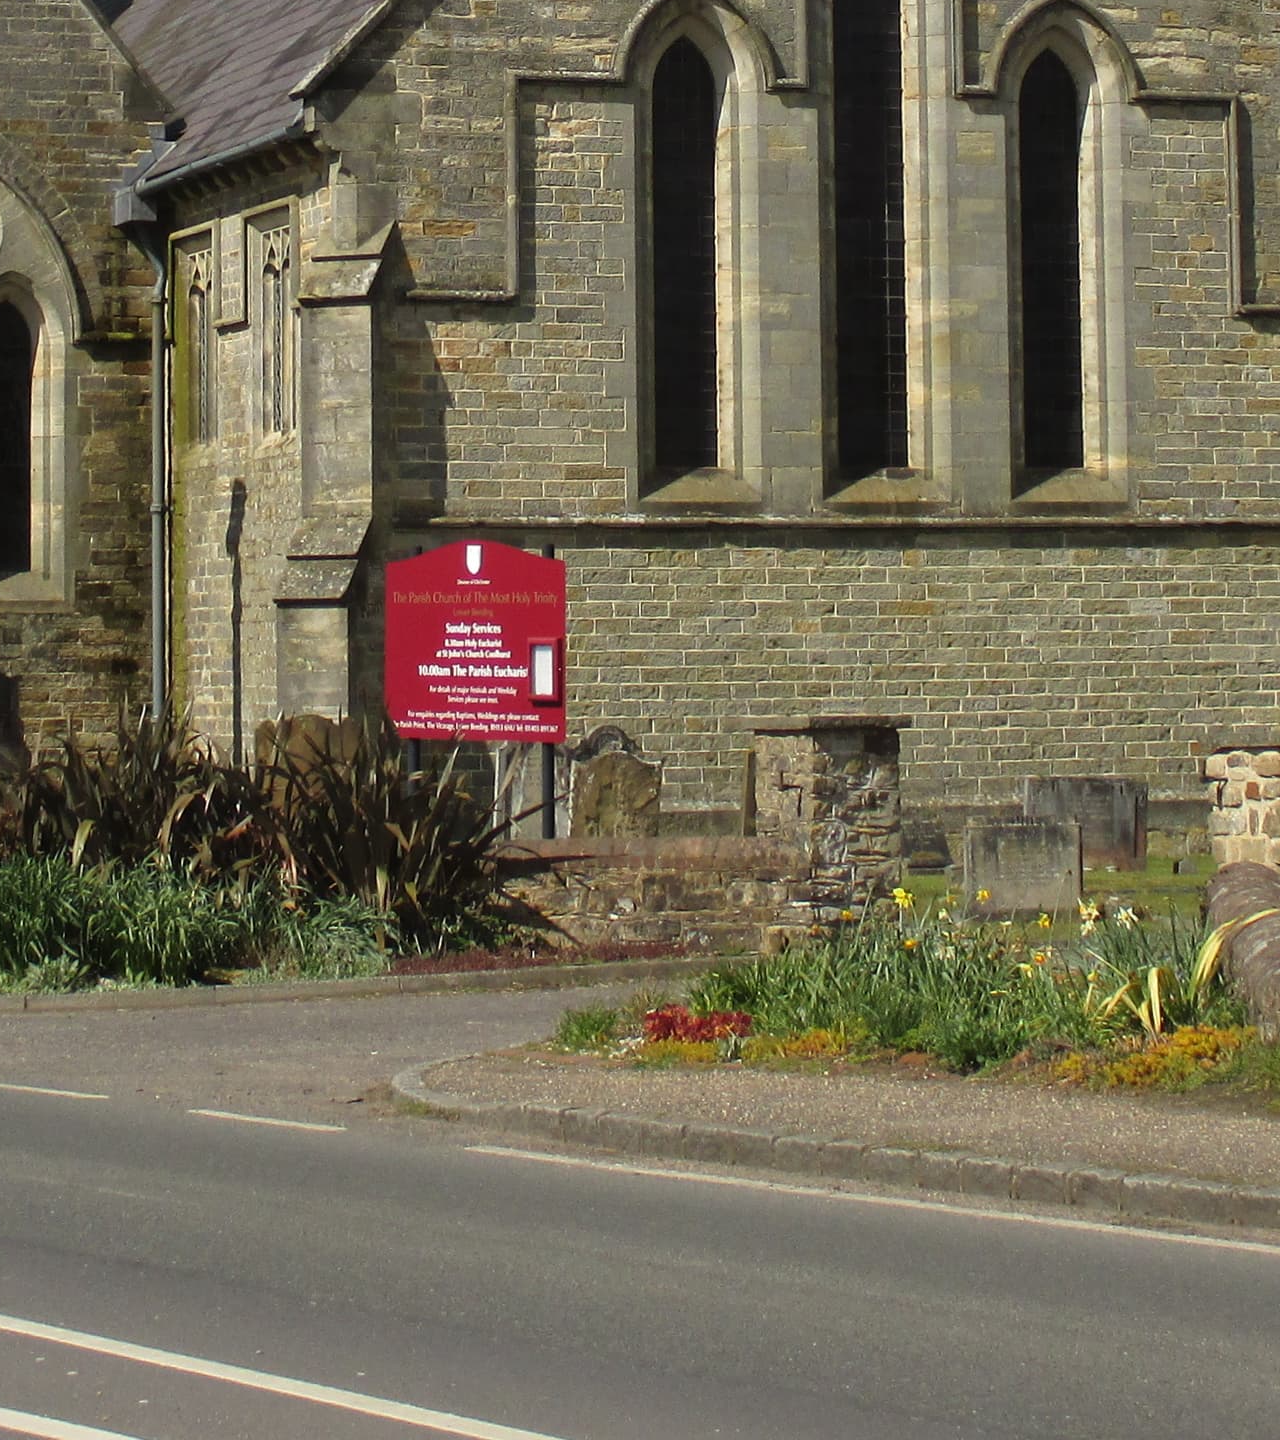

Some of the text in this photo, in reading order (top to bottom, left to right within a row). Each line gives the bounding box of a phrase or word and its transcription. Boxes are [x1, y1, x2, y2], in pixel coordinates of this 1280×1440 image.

[394, 592, 558, 608] The Parish Church of The Most Holy Trinity
[445, 622, 502, 637] Sunday Services
[465, 638, 477, 650] Holy
[478, 639, 502, 647] Eucharist
[465, 650, 484, 658] Church
[419, 664, 450, 676] 10.00am
[452, 664, 467, 677] The
[469, 664, 492, 677] Parish
